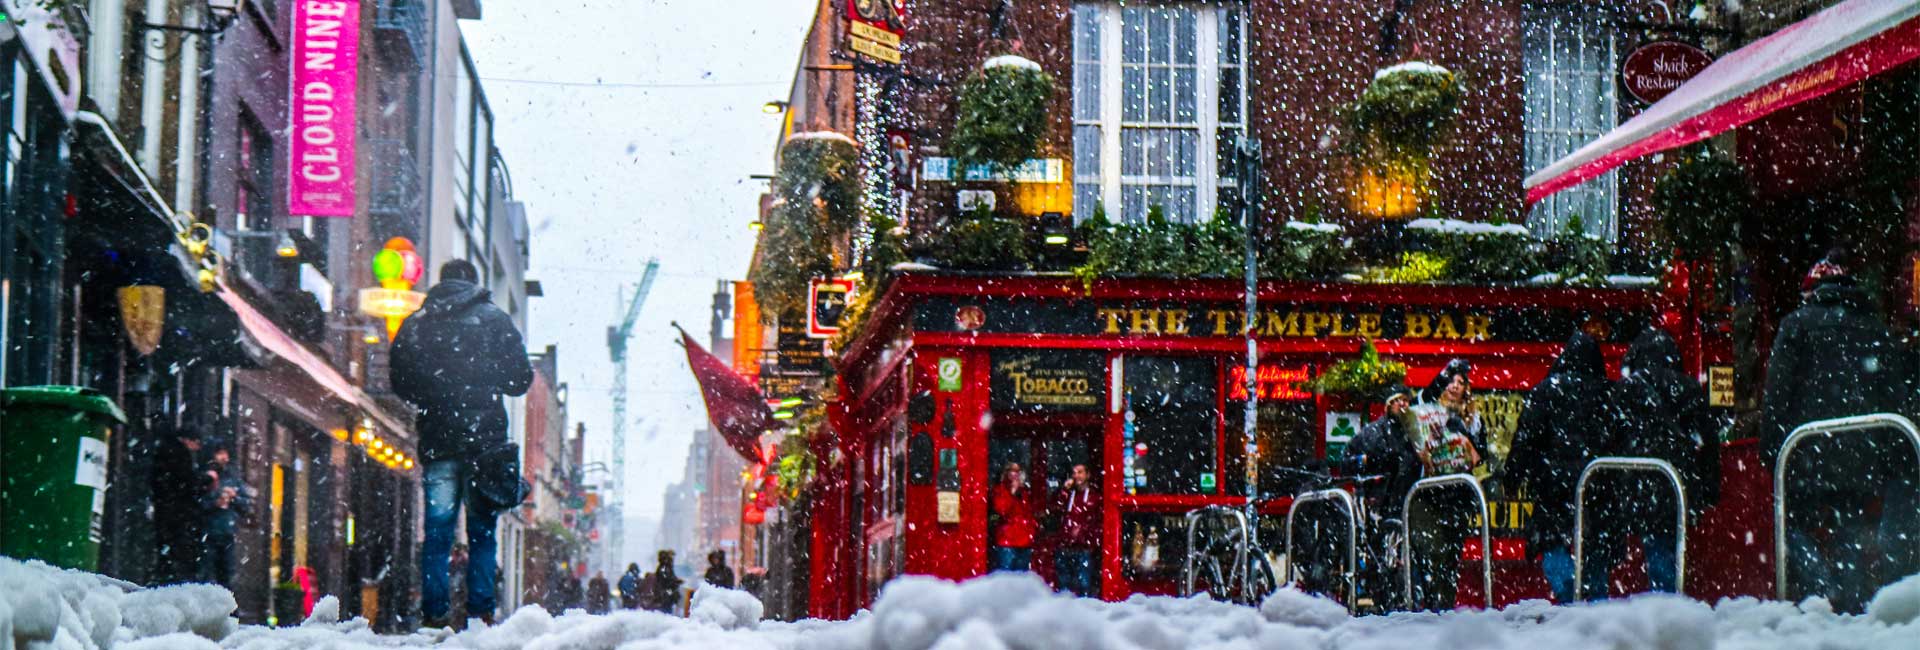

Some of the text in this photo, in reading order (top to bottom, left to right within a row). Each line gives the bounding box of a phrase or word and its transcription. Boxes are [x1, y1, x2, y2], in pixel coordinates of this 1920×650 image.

[305, 1, 347, 70] NINE
[1653, 52, 1689, 73] Shack
[302, 81, 341, 182] CLOUD
[1098, 309, 1492, 341] THE TEMPLE BAR
